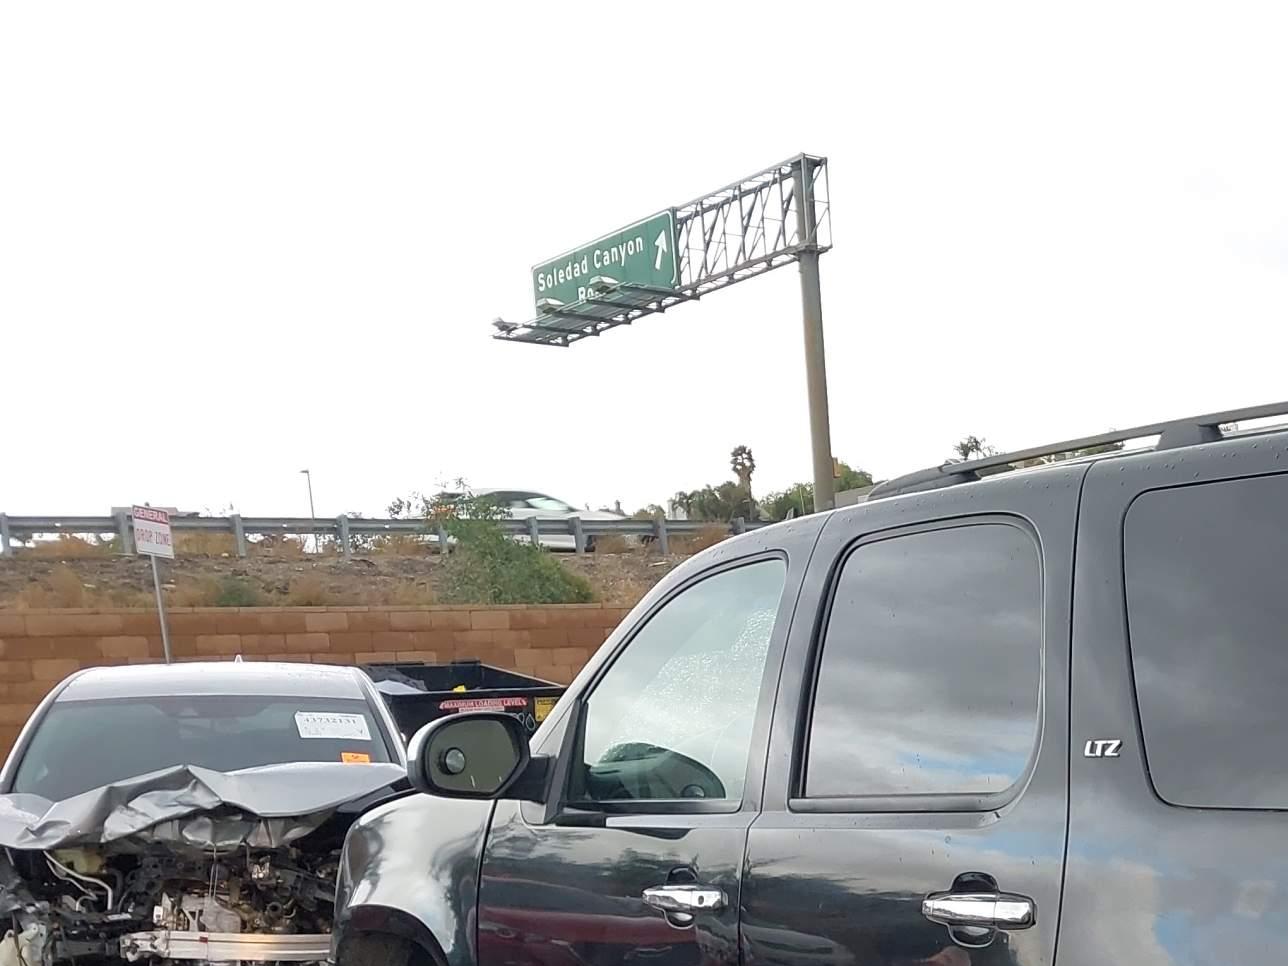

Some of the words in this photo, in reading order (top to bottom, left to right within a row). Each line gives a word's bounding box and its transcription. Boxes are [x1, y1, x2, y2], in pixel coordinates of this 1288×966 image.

[537, 254, 588, 291] Soledad
[593, 236, 643, 269] Canyon
[1084, 739, 1121, 757] LTZ
